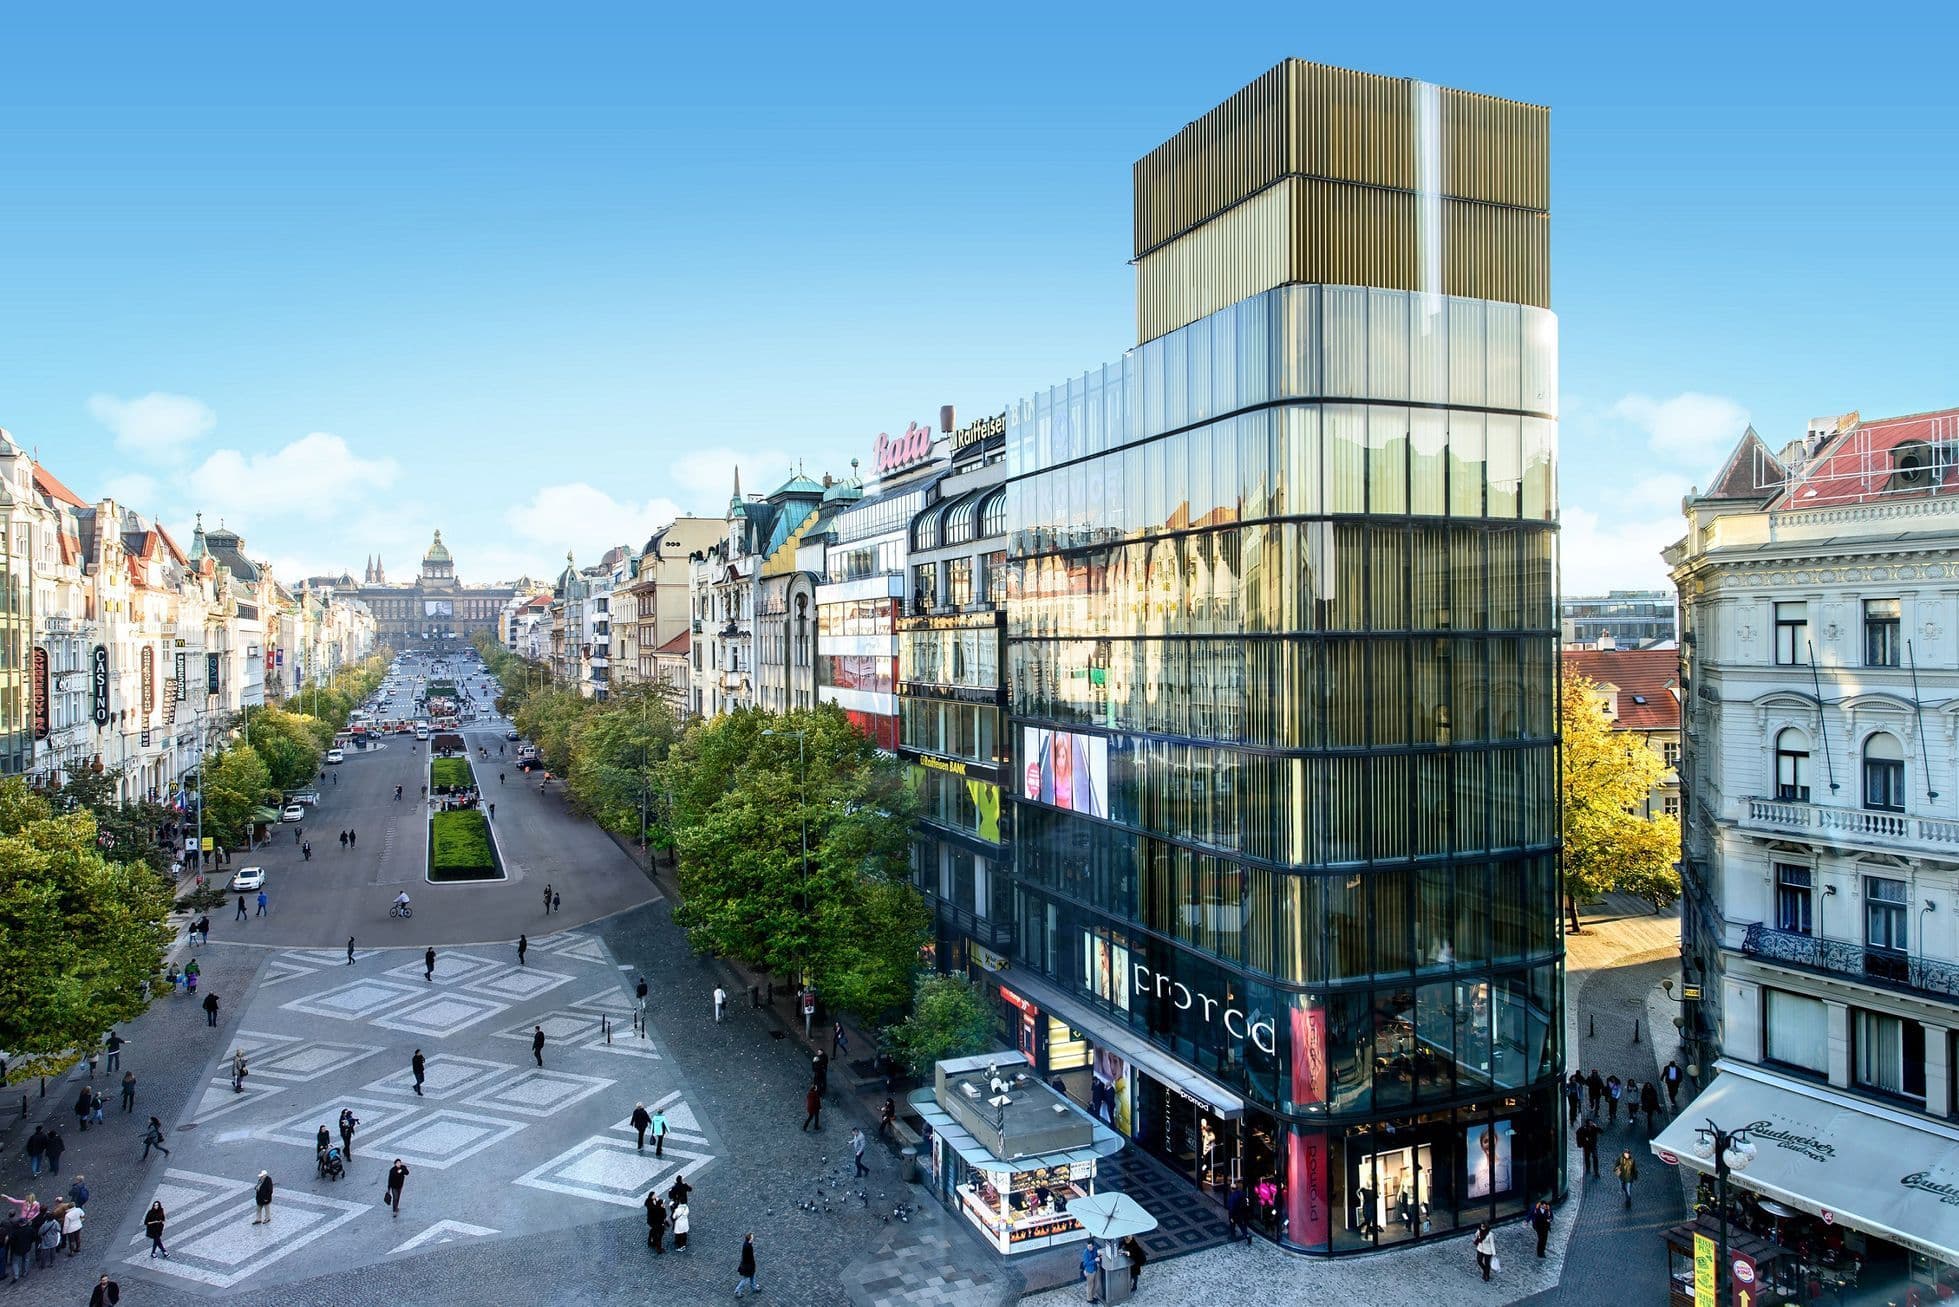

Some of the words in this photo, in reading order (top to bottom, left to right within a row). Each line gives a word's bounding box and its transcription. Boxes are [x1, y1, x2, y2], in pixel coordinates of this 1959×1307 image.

[96, 651, 105, 720] CASINO
[949, 761, 966, 776] BANK
[1180, 1091, 1209, 1112] promod
[1745, 1120, 1836, 1157] Budweiser
[1776, 1141, 1827, 1162] Budvar
